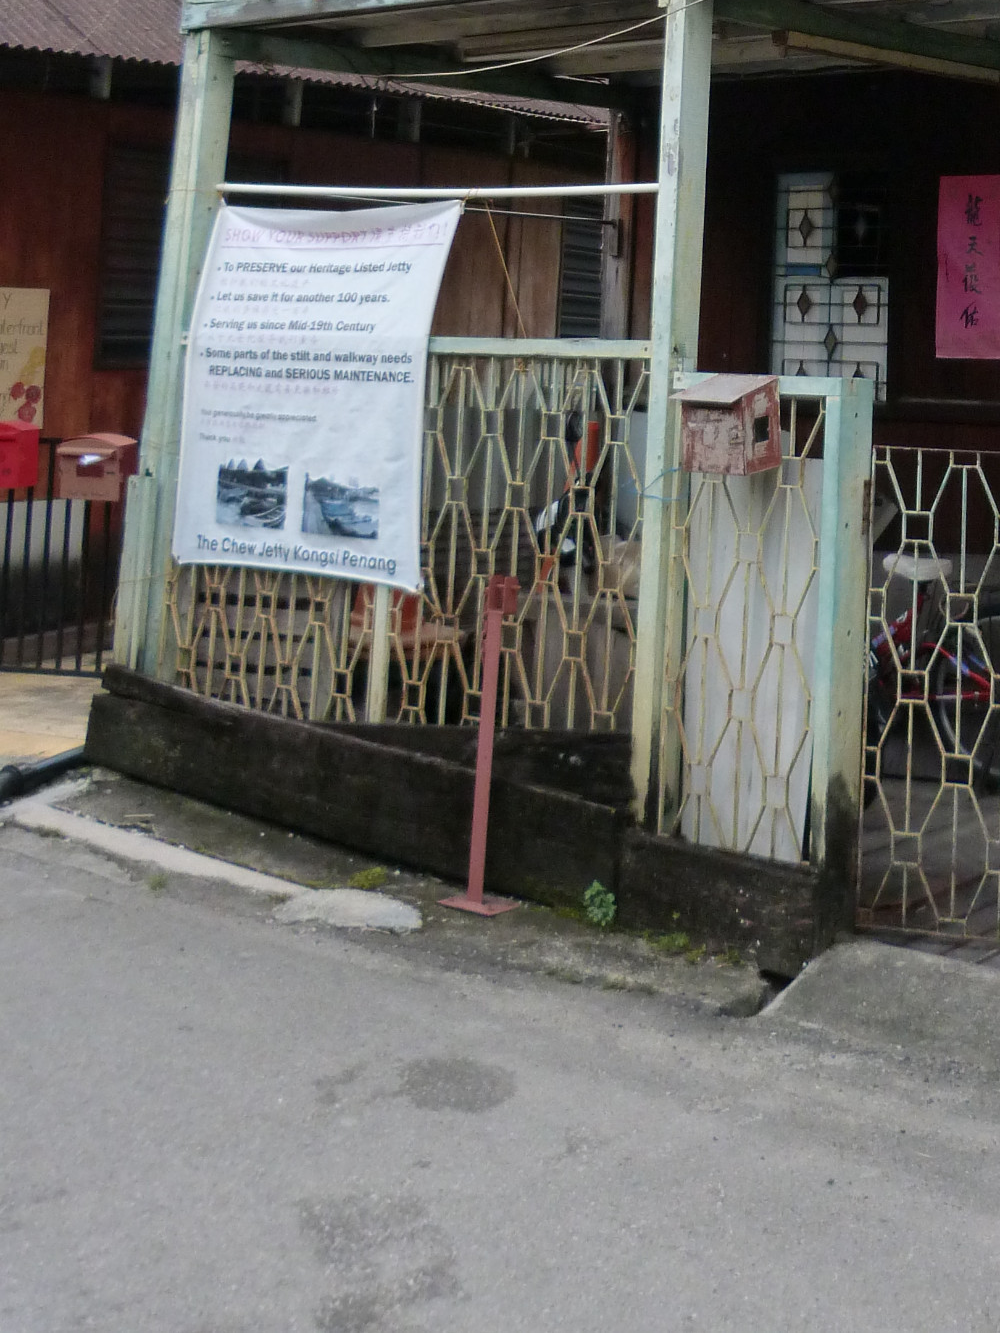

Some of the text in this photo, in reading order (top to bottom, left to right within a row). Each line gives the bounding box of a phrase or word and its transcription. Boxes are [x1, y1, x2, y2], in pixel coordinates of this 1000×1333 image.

[225, 228, 265, 241] SHOW
[269, 229, 304, 243] YOUR
[308, 230, 368, 243] SUPPORT
[224, 261, 413, 275] To PRESERVE our Heritage Listed Jetty
[217, 292, 391, 305] Let us save it for another 100 years.
[210, 319, 376, 334] Serving us since Mid-19th Century
[206, 348, 413, 365] Some parts of the stilt and walkway needs
[209, 365, 415, 383] REPLACING and SERIOUS MAINTENANCE.
[197, 534, 397, 575] The Chew Jetty Kongsi Penang
